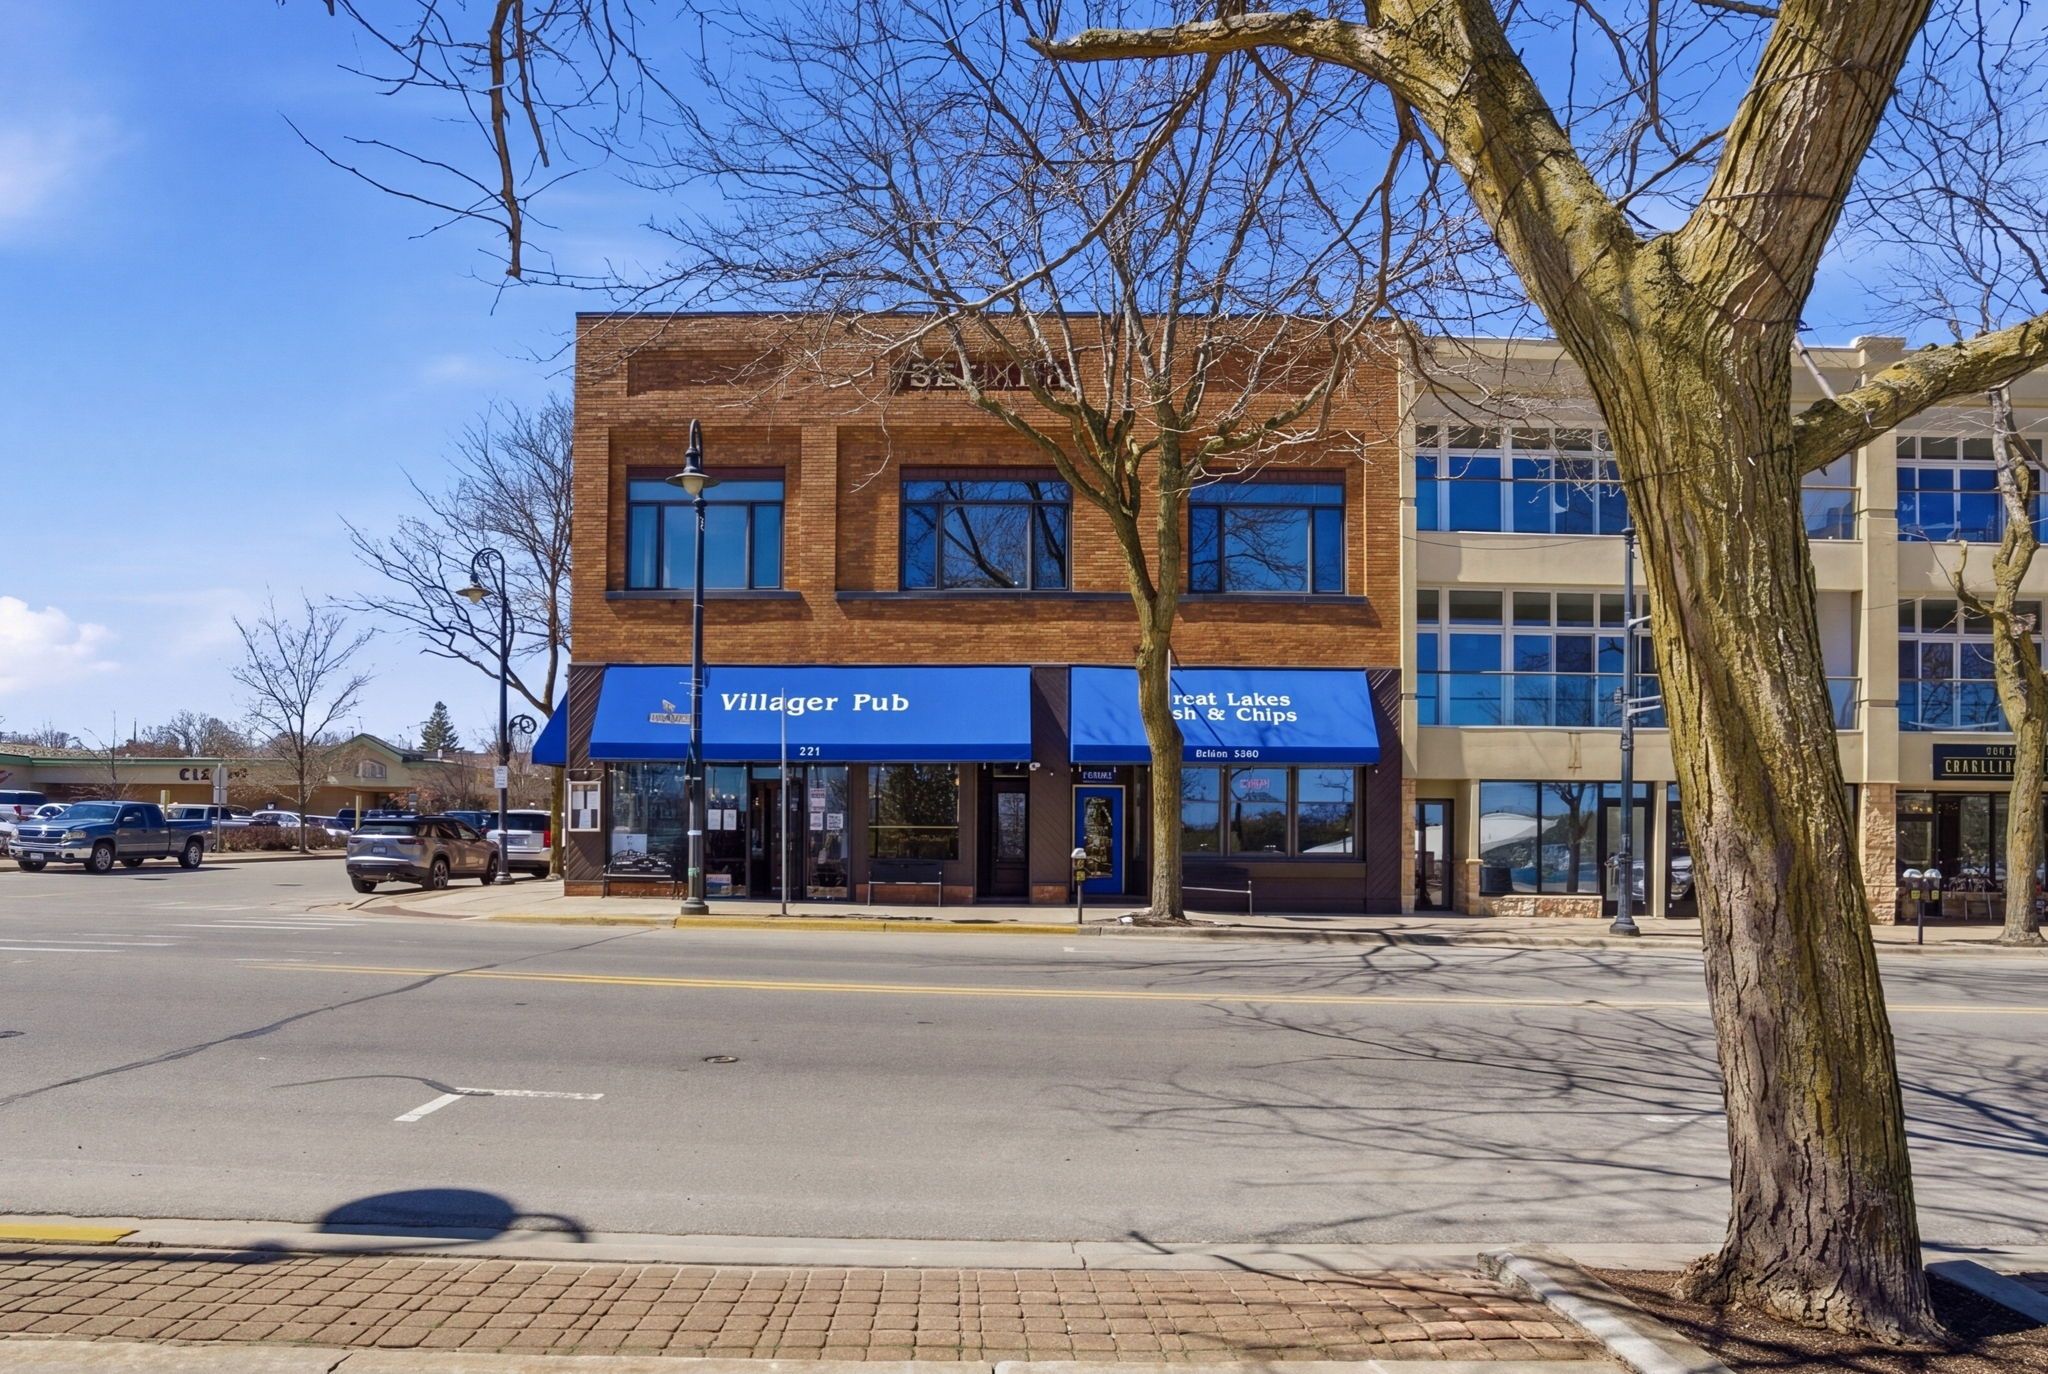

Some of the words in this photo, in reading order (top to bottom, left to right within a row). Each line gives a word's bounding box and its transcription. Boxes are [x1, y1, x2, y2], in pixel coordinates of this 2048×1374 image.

[721, 692, 839, 716] Villager
[852, 693, 910, 712] Pub
[1173, 692, 1218, 706] reat
[1226, 692, 1291, 707] Lakes
[1172, 707, 1197, 720] sh
[1207, 708, 1226, 721] &
[1236, 707, 1298, 725] Chips
[799, 746, 820, 757] 221
